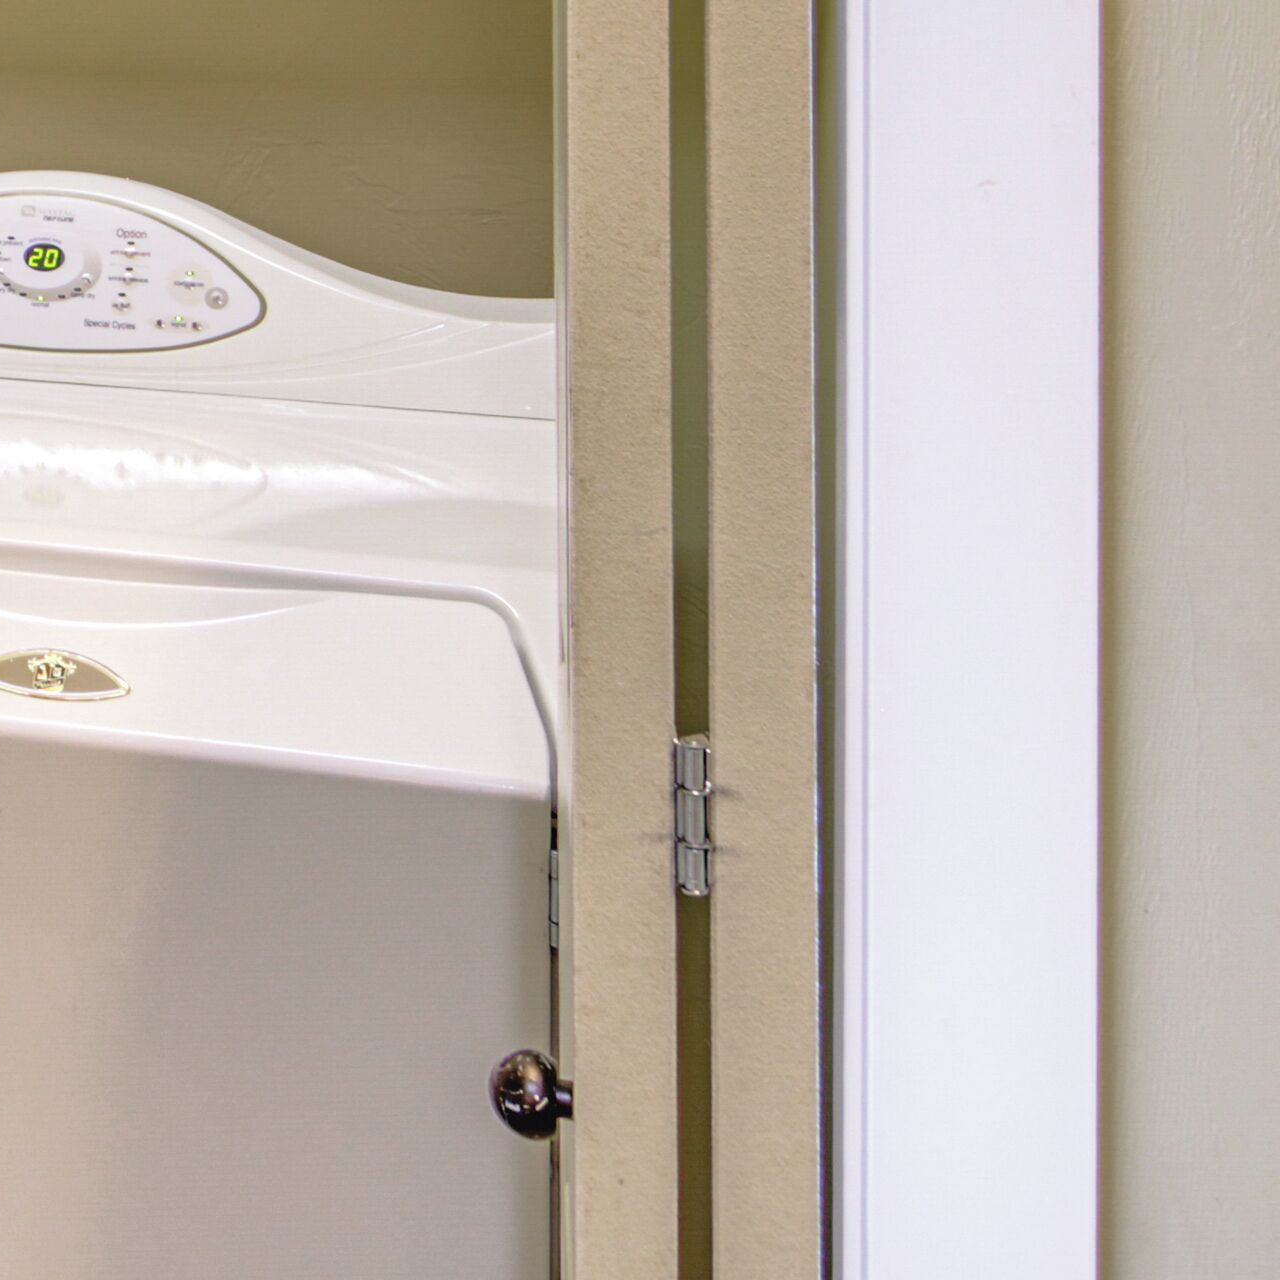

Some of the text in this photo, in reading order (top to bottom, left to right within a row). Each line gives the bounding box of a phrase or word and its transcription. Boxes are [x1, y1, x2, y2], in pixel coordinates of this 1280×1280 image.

[116, 228, 147, 239] Option
[28, 247, 59, 268] 20
[83, 318, 137, 330] Special Cycles
